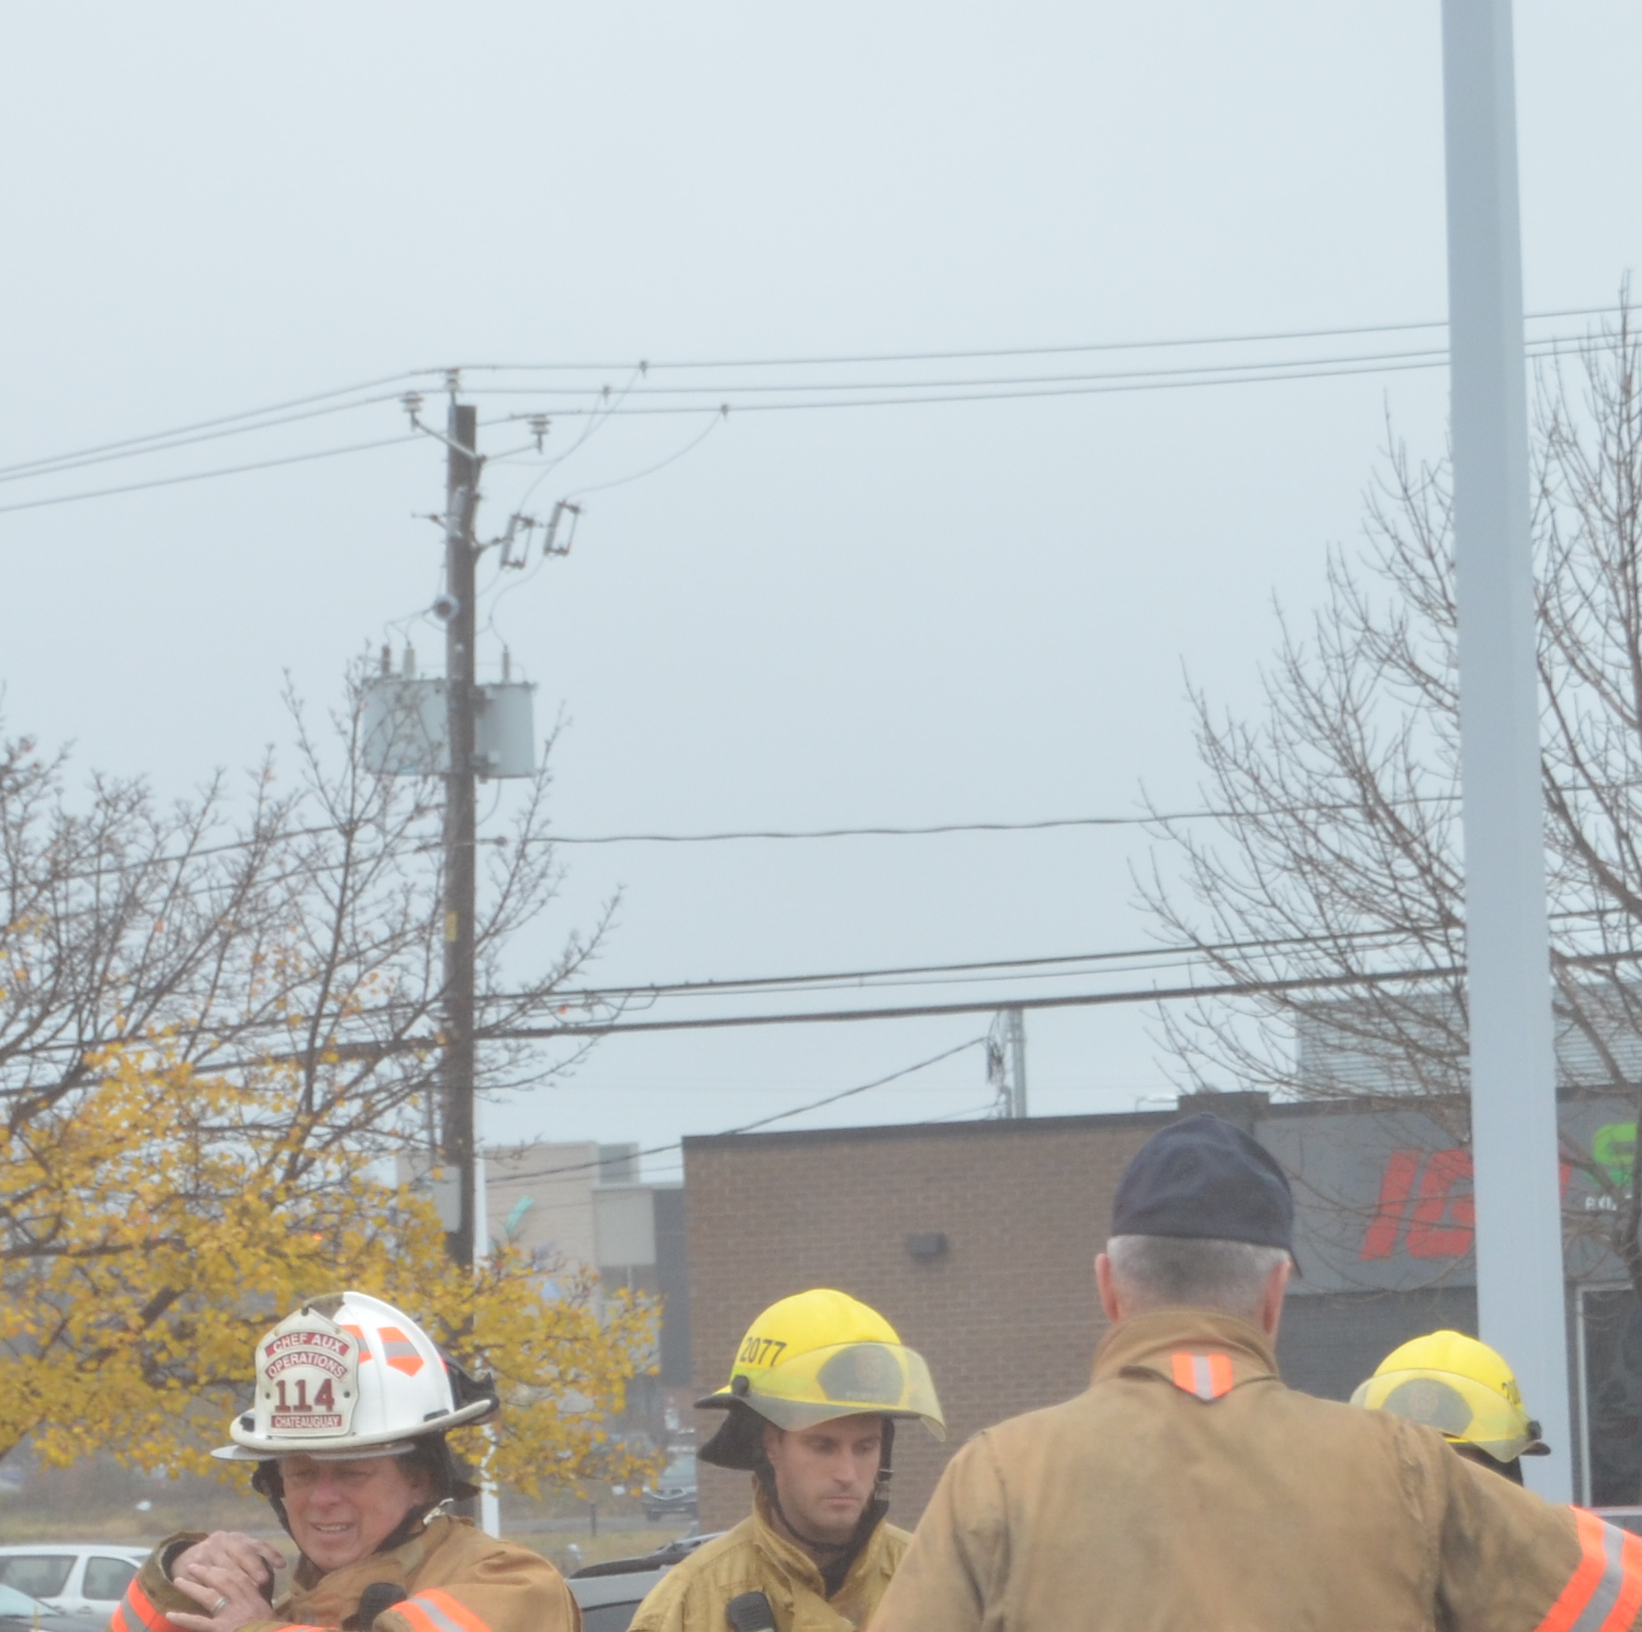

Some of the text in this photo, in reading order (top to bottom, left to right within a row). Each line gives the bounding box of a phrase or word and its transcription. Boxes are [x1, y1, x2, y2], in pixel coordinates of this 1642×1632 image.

[272, 1333, 344, 1353] CHEF AUX
[739, 1337, 787, 1367] 2077
[268, 1352, 344, 1377] OPERATIONS
[275, 1378, 335, 1412] 114
[274, 1416, 339, 1428] CHATEAUGUAY
